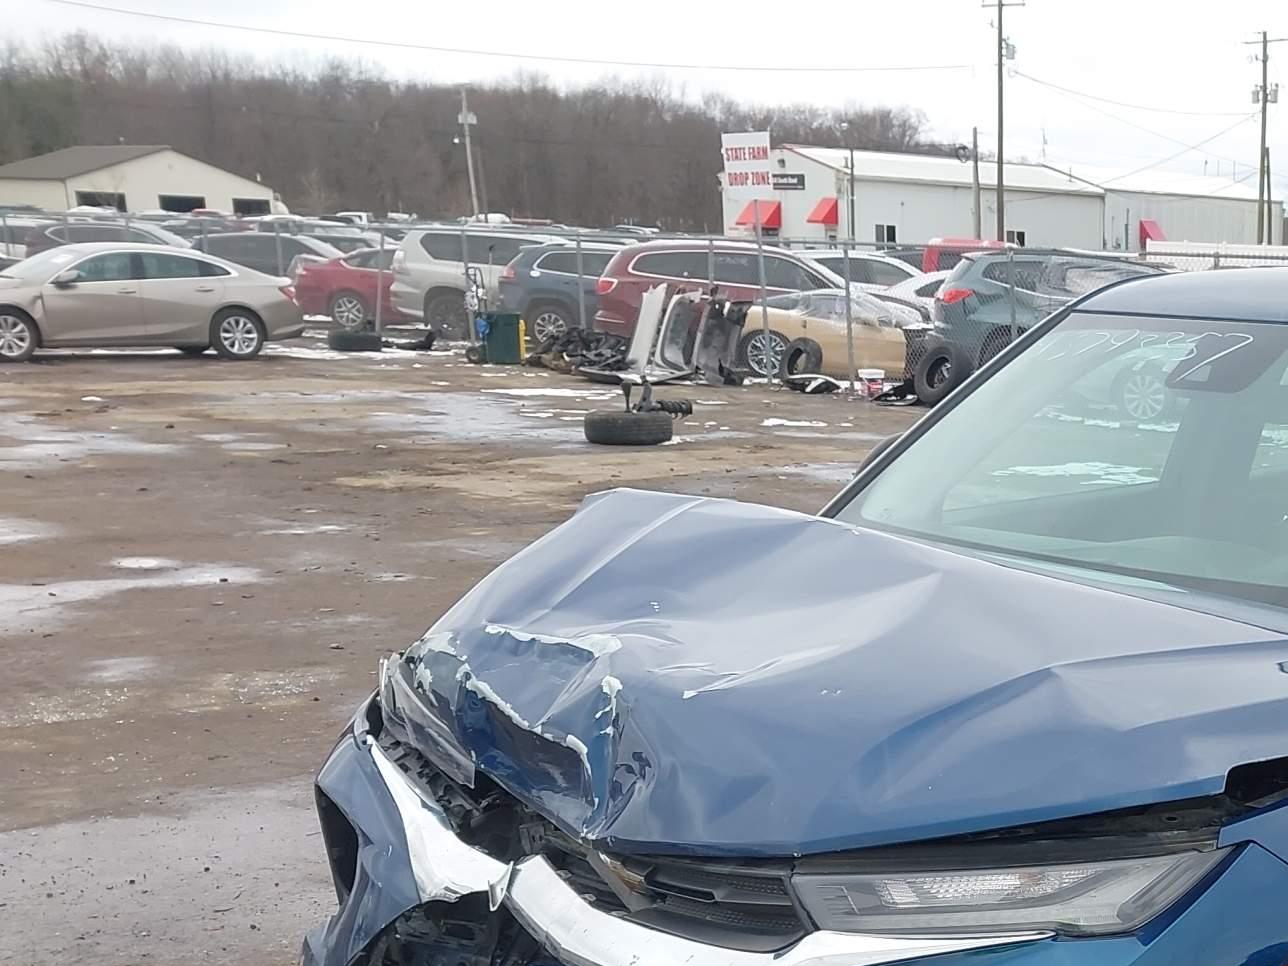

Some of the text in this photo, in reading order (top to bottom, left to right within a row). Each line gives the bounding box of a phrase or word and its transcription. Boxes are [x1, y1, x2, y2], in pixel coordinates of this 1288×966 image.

[725, 145, 768, 161] STATE FARM
[728, 172, 749, 186] DROP
[751, 171, 770, 185] ZONE
